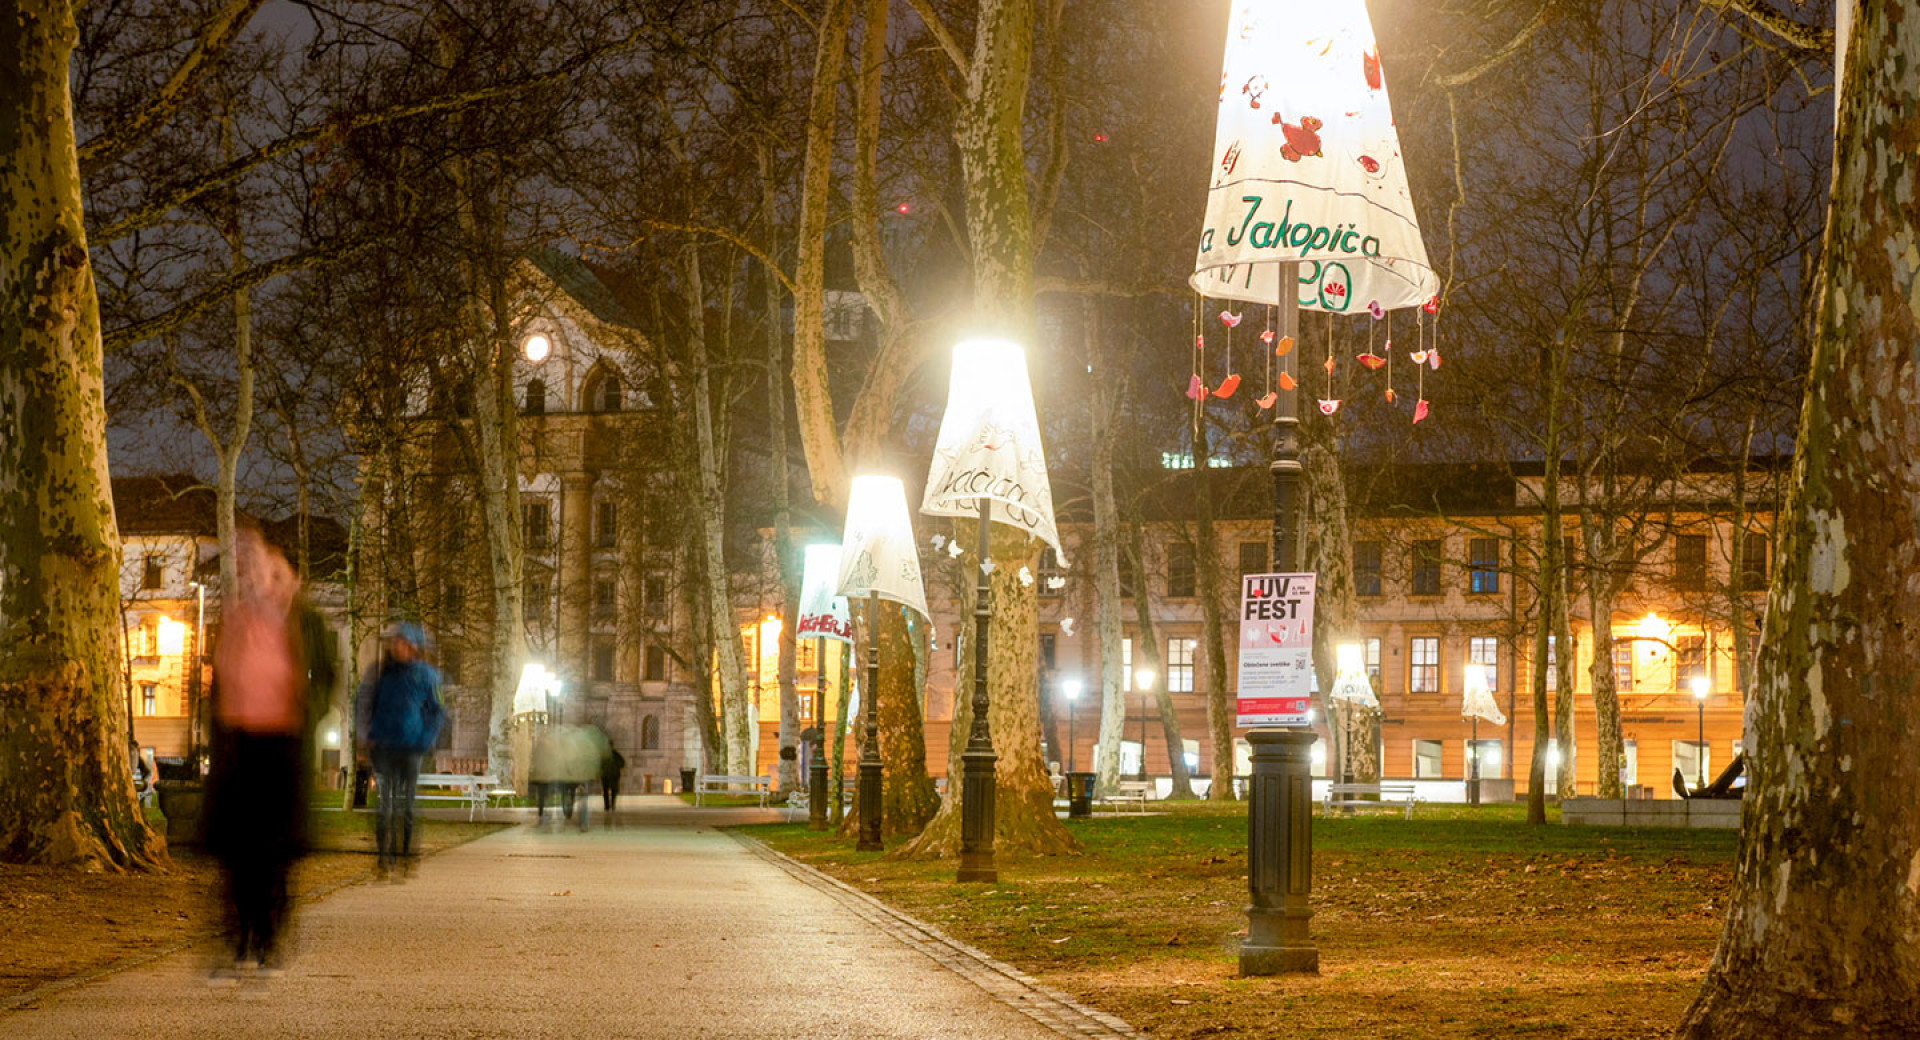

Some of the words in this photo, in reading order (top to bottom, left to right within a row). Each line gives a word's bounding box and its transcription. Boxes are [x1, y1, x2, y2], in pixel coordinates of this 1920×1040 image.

[1226, 195, 1381, 258] Jakopiča
[1246, 578, 1290, 599] LUV
[1244, 599, 1301, 621] FEST
